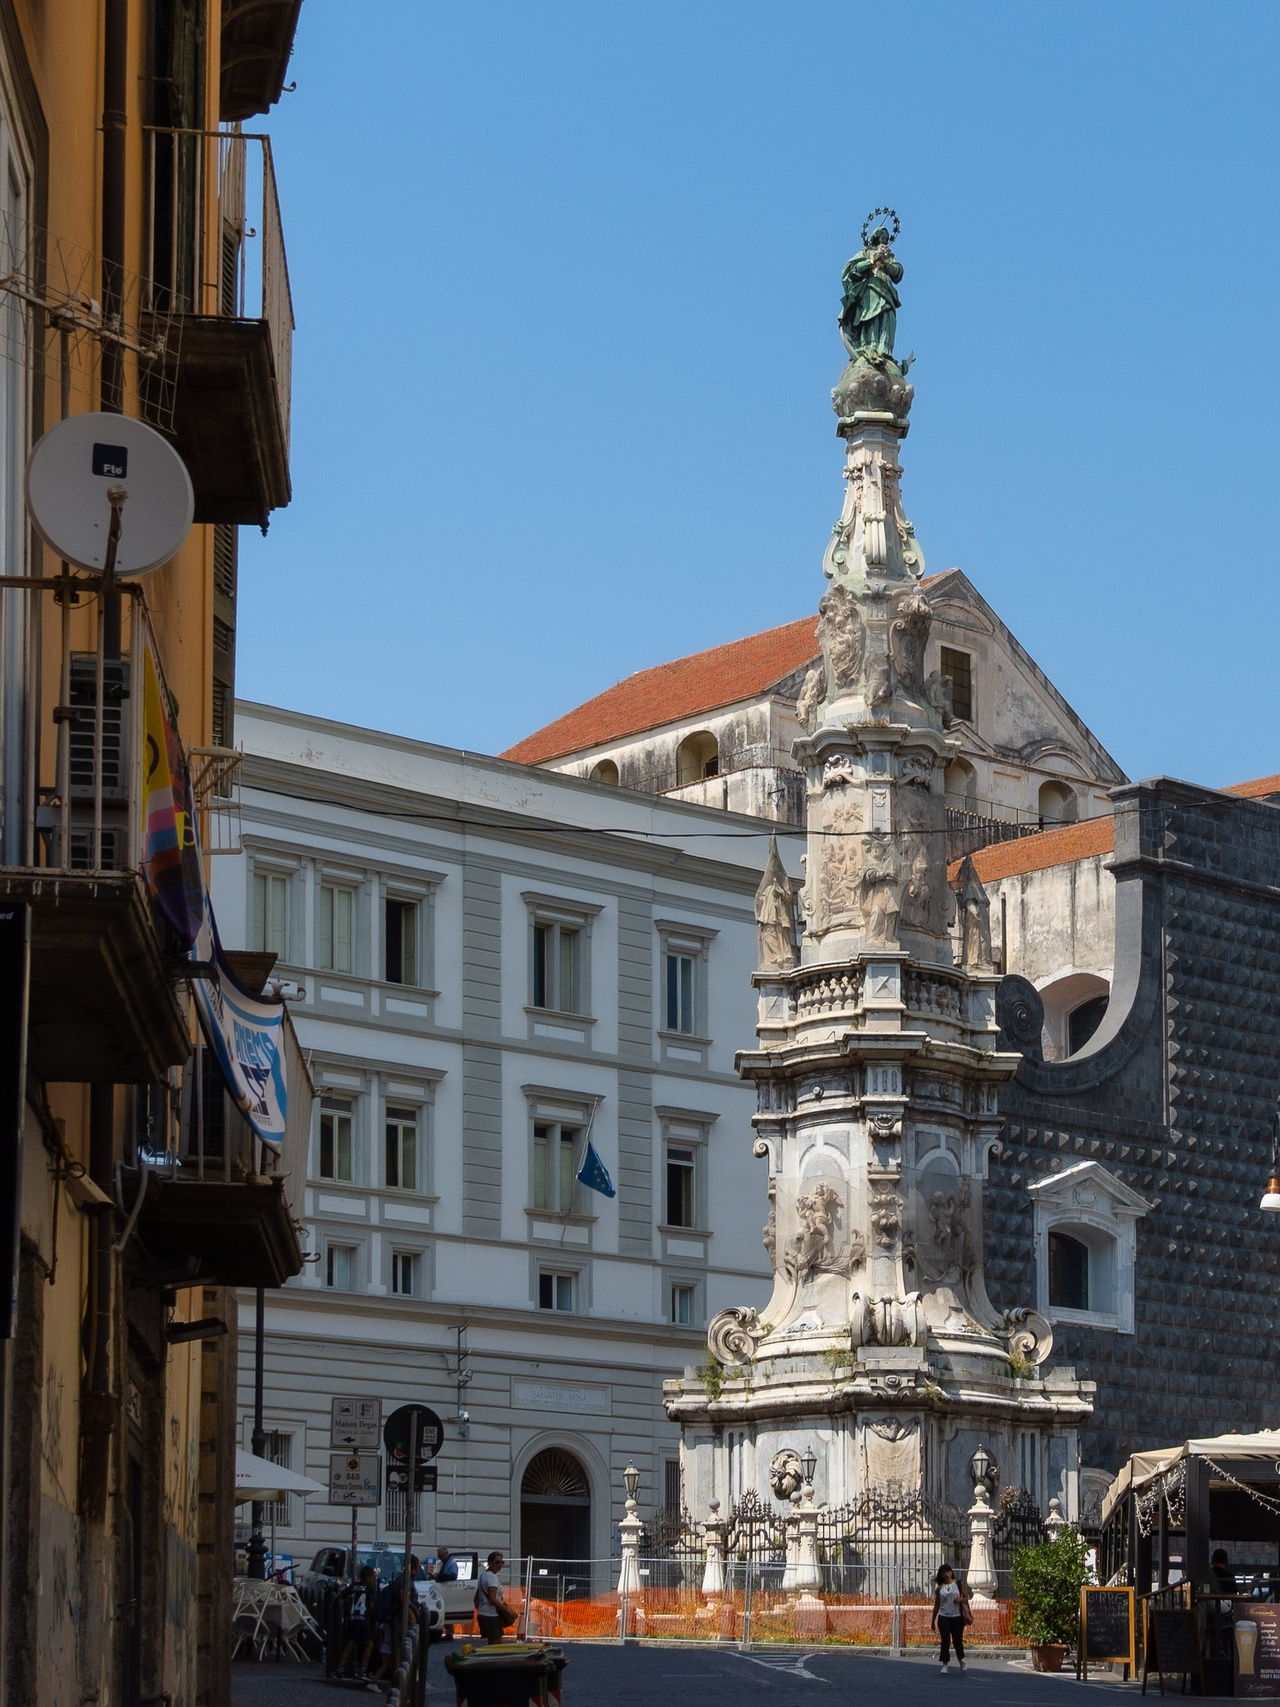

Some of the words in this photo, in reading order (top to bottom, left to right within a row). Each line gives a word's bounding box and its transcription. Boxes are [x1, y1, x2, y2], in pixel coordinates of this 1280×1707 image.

[334, 1419, 358, 1428] Maison
[359, 1420, 378, 1430] Degas
[346, 1472, 360, 1481] B&B
[350, 1592, 367, 1615] 14
